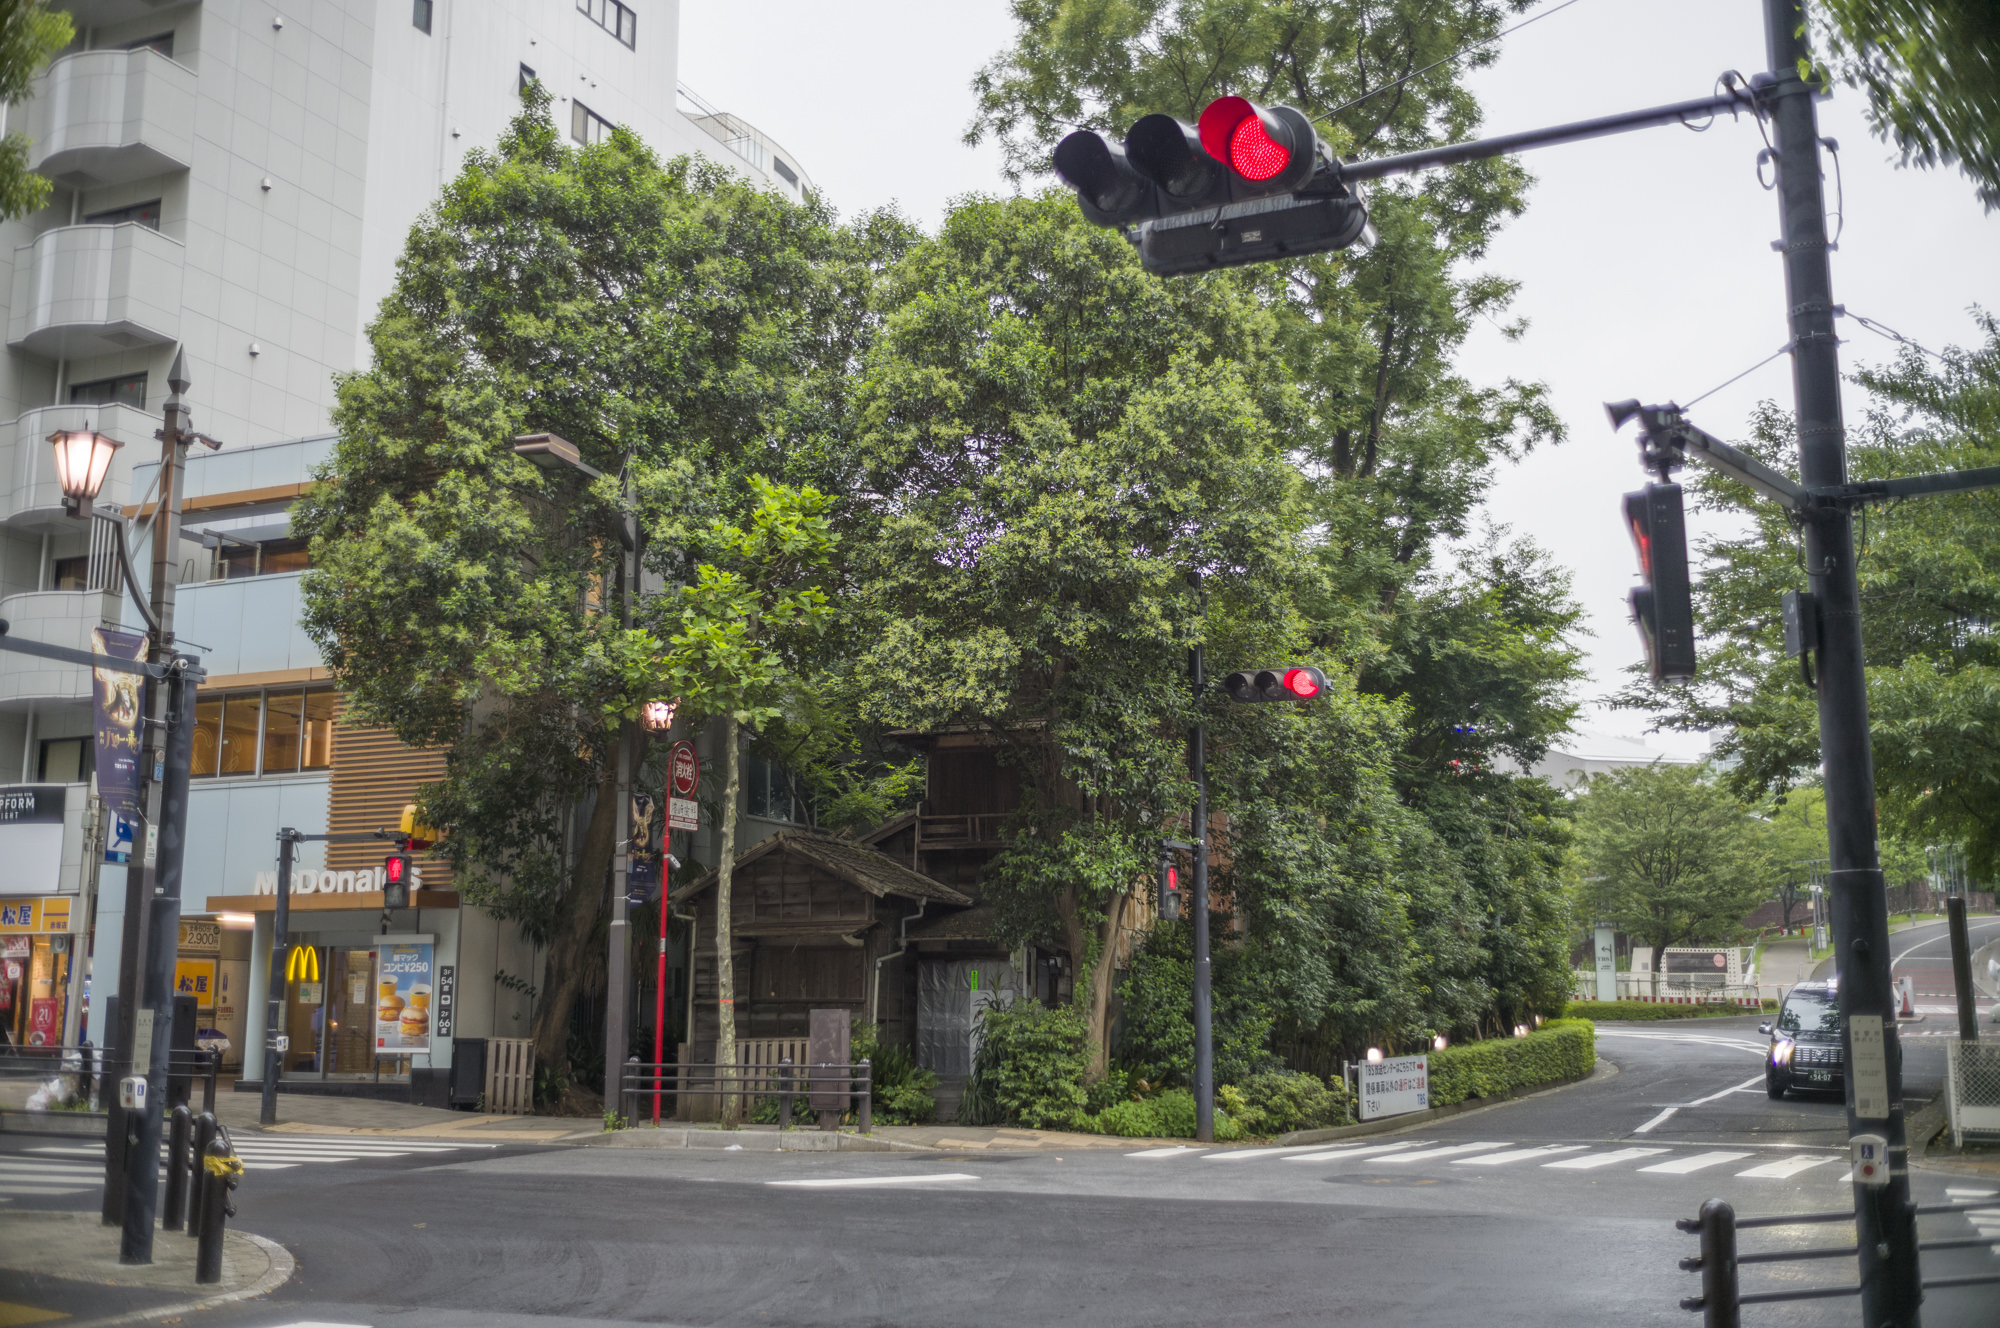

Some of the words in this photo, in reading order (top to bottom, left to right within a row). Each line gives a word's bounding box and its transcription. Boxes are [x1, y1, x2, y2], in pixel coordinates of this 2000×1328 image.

[675, 760, 693, 781] 消火栓
[1, 904, 32, 926] 松屋
[383, 961, 429, 973] コンビ¥250
[178, 974, 208, 993] 松屋
[441, 977, 452, 985] 54
[439, 1019, 450, 1027] 66
[1365, 1061, 1416, 1077] TBS放送センターはこちらです
[1366, 1099, 1380, 1113] 下さい
[1417, 1093, 1426, 1105] TBS
